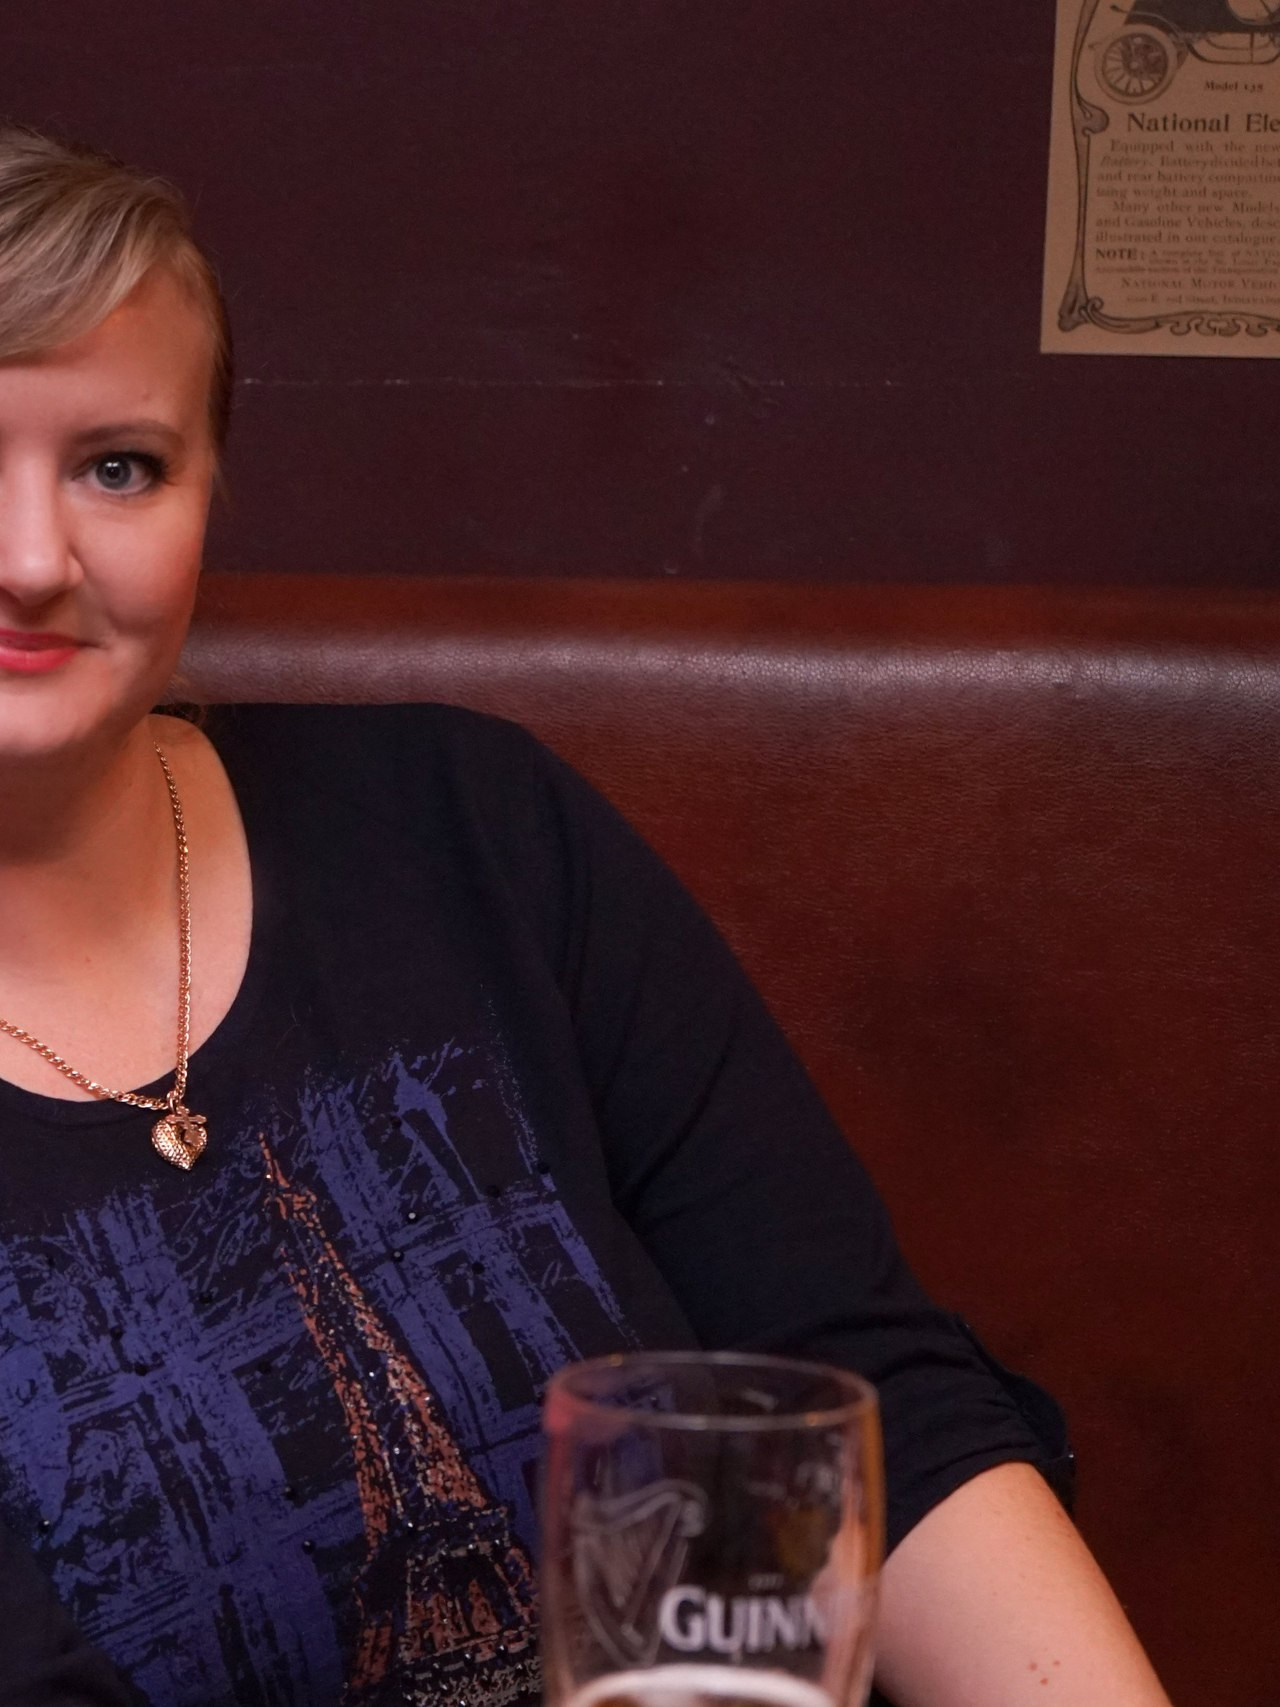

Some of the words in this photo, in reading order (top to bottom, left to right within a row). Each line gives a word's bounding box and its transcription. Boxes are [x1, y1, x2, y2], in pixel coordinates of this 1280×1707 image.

[1127, 112, 1230, 133] National
[1110, 139, 1174, 155] Equipped
[1184, 140, 1214, 153] with
[1224, 140, 1246, 153] the
[1097, 170, 1123, 182] and
[1181, 186, 1206, 198] and
[1112, 200, 1149, 214] Many
[1096, 215, 1121, 228] and
